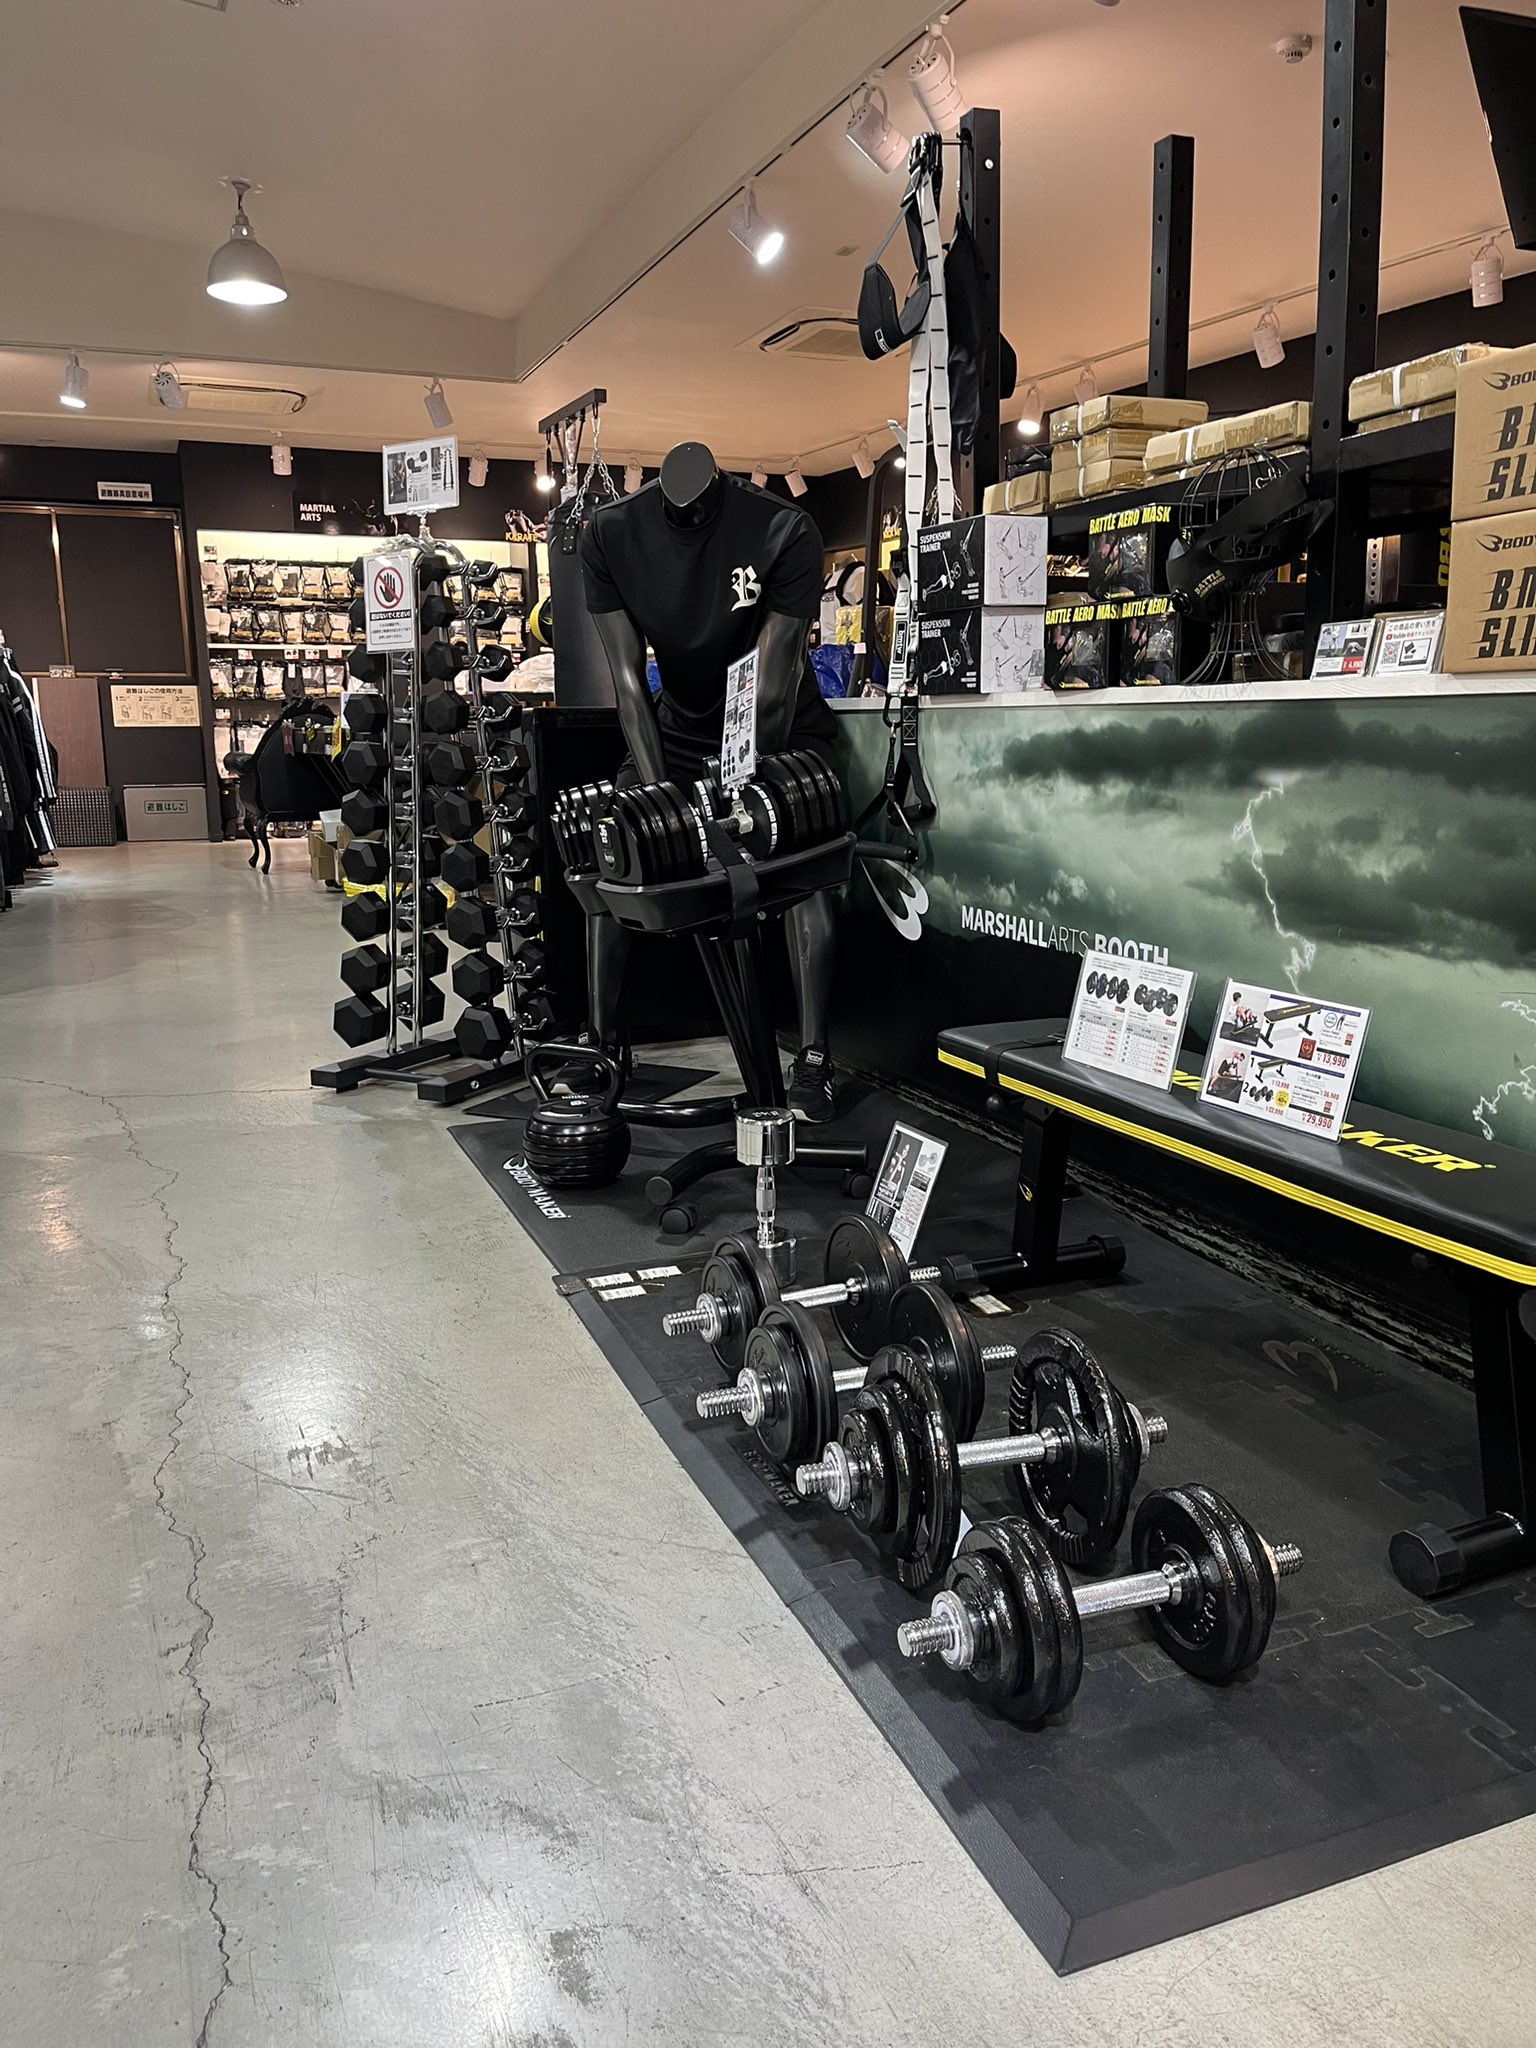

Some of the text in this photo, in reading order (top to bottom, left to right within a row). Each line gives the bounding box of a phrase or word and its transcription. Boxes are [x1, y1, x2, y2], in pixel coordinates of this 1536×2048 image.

[299, 503, 336, 513] MARTIAL
[300, 513, 322, 522] ARTS
[1089, 505, 1172, 535] BATTLE AERO MASK
[505, 531, 537, 542] KARATE
[919, 530, 952, 545] SUSPENSION
[920, 541, 942, 554] TRAINER
[1194, 569, 1224, 595] BATTLE
[1121, 600, 1146, 618] BATTLE
[1146, 597, 1168, 615] AERO
[1045, 608, 1072, 625] BATTLE
[1072, 605, 1095, 622] AERO
[921, 618, 951, 630] SUSPENSION
[921, 629, 942, 639] TRAINER
[146, 802, 185, 811] 避難はしご
[1094, 932, 1169, 966] BOOTH
[508, 1169, 567, 1219] BODYMAKER
